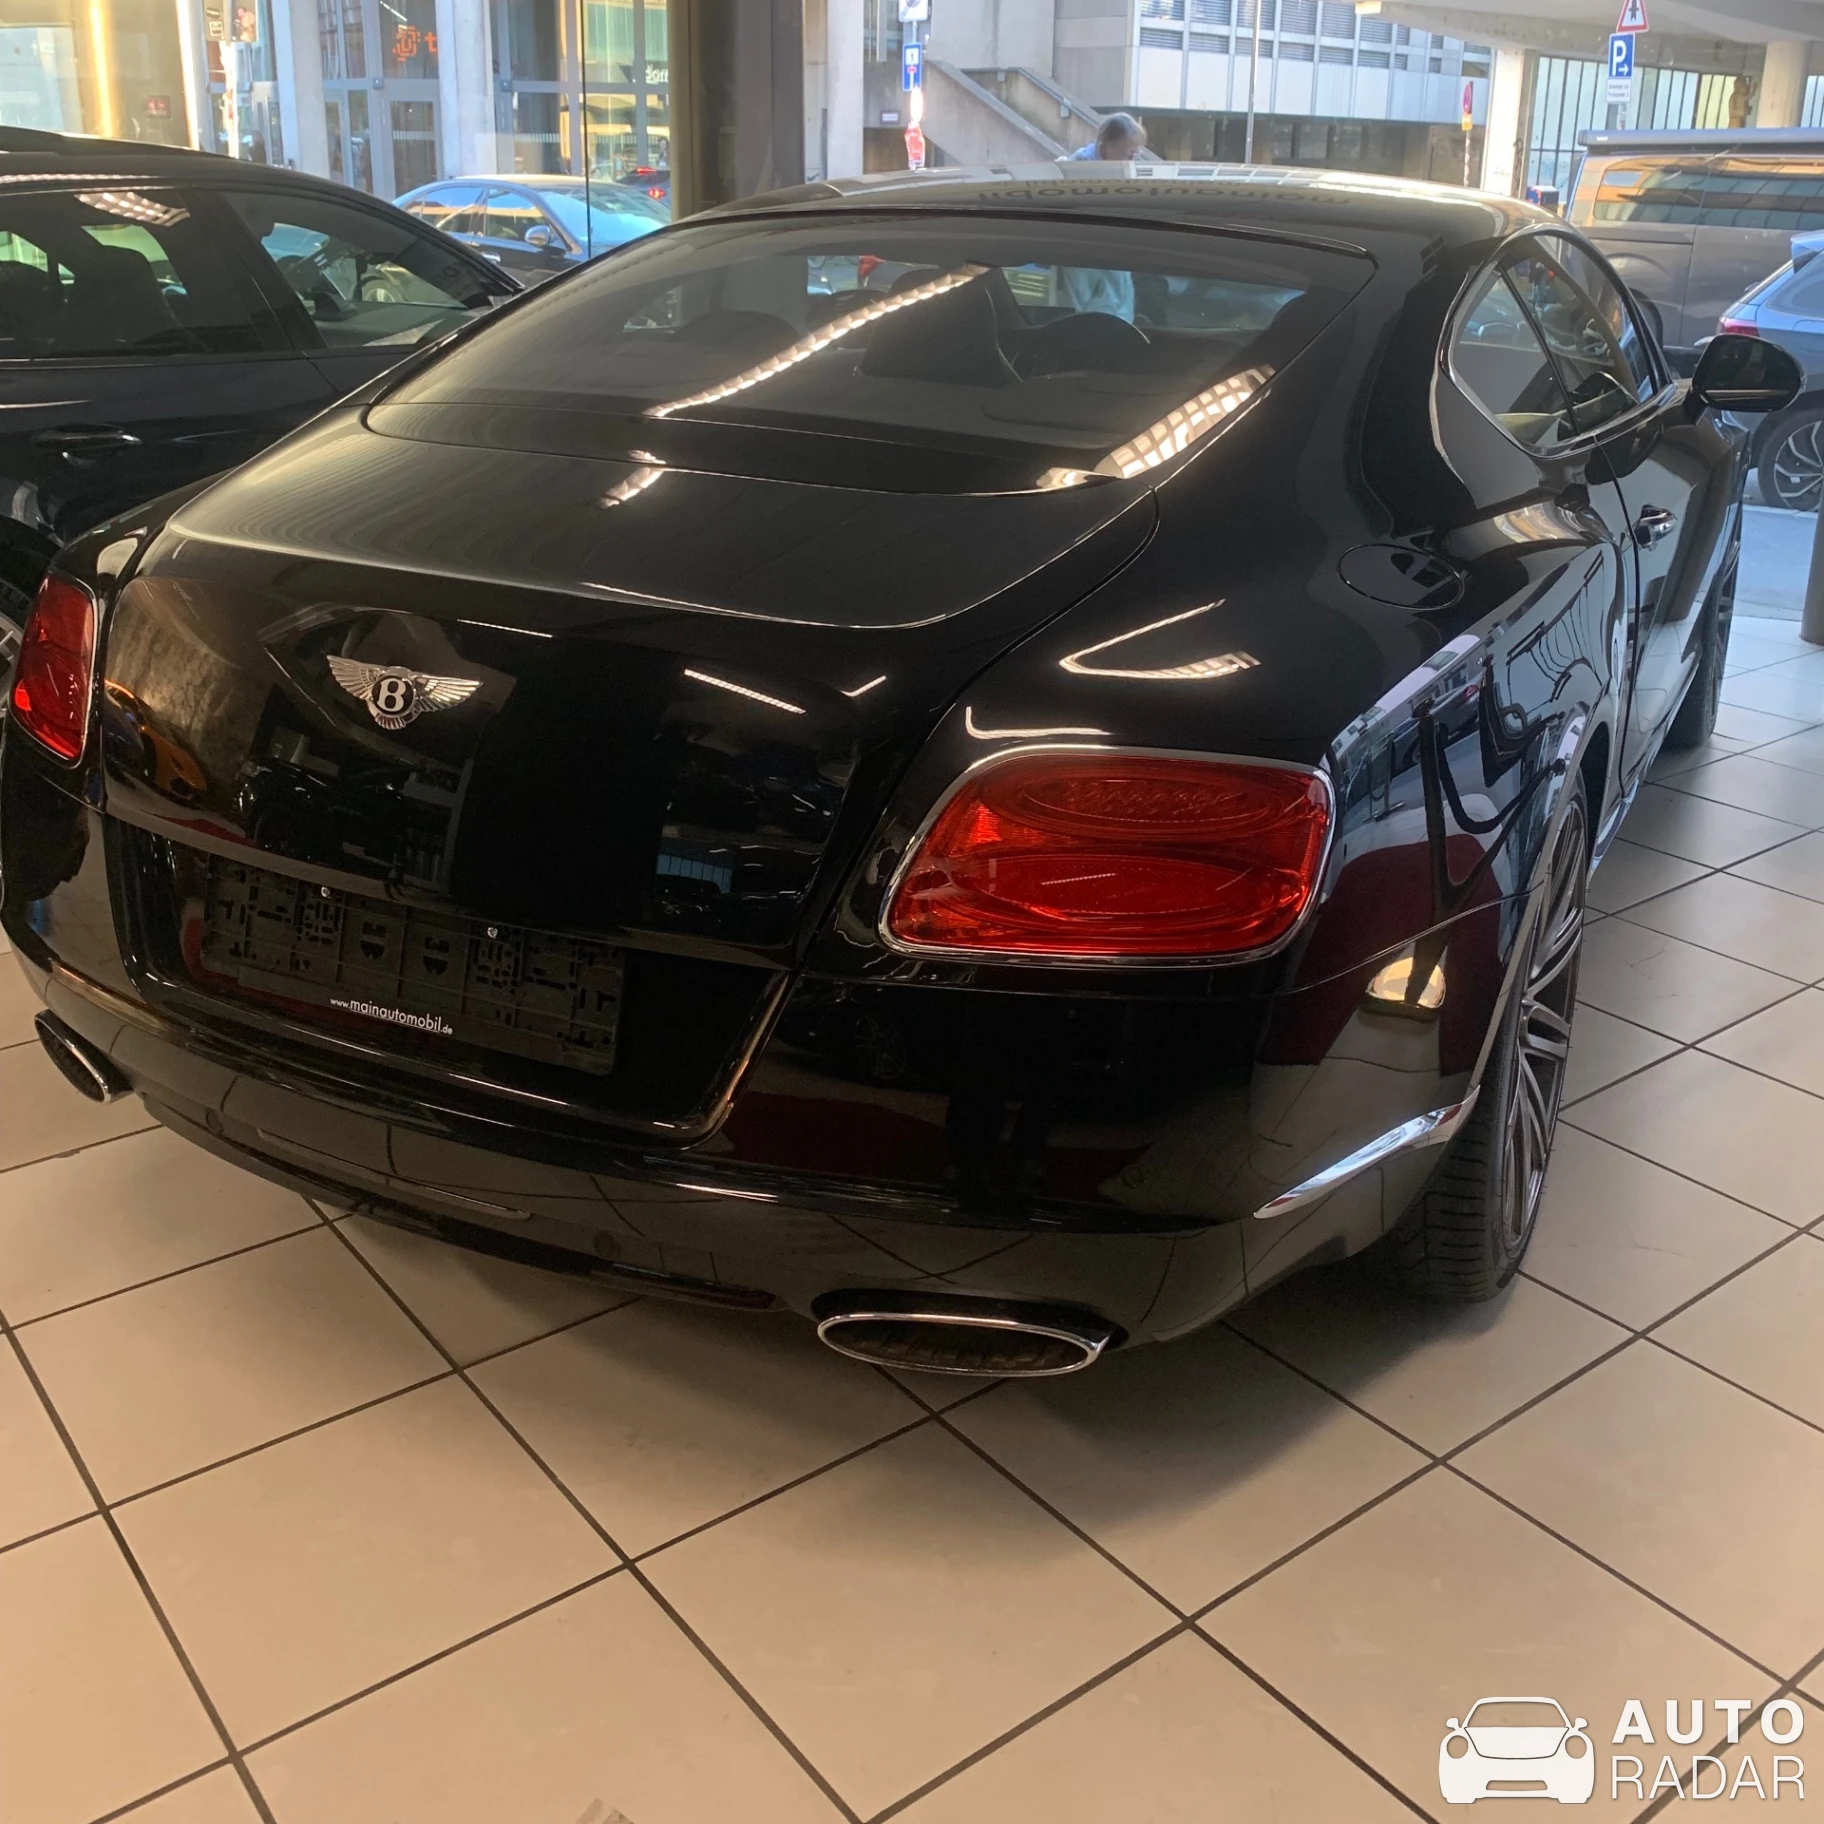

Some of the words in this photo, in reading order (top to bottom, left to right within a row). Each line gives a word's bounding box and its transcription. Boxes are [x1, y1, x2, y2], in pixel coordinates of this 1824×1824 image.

[1612, 39, 1627, 76] P
[377, 677, 406, 712] B
[330, 998, 453, 1034] www.mainautomobil.de
